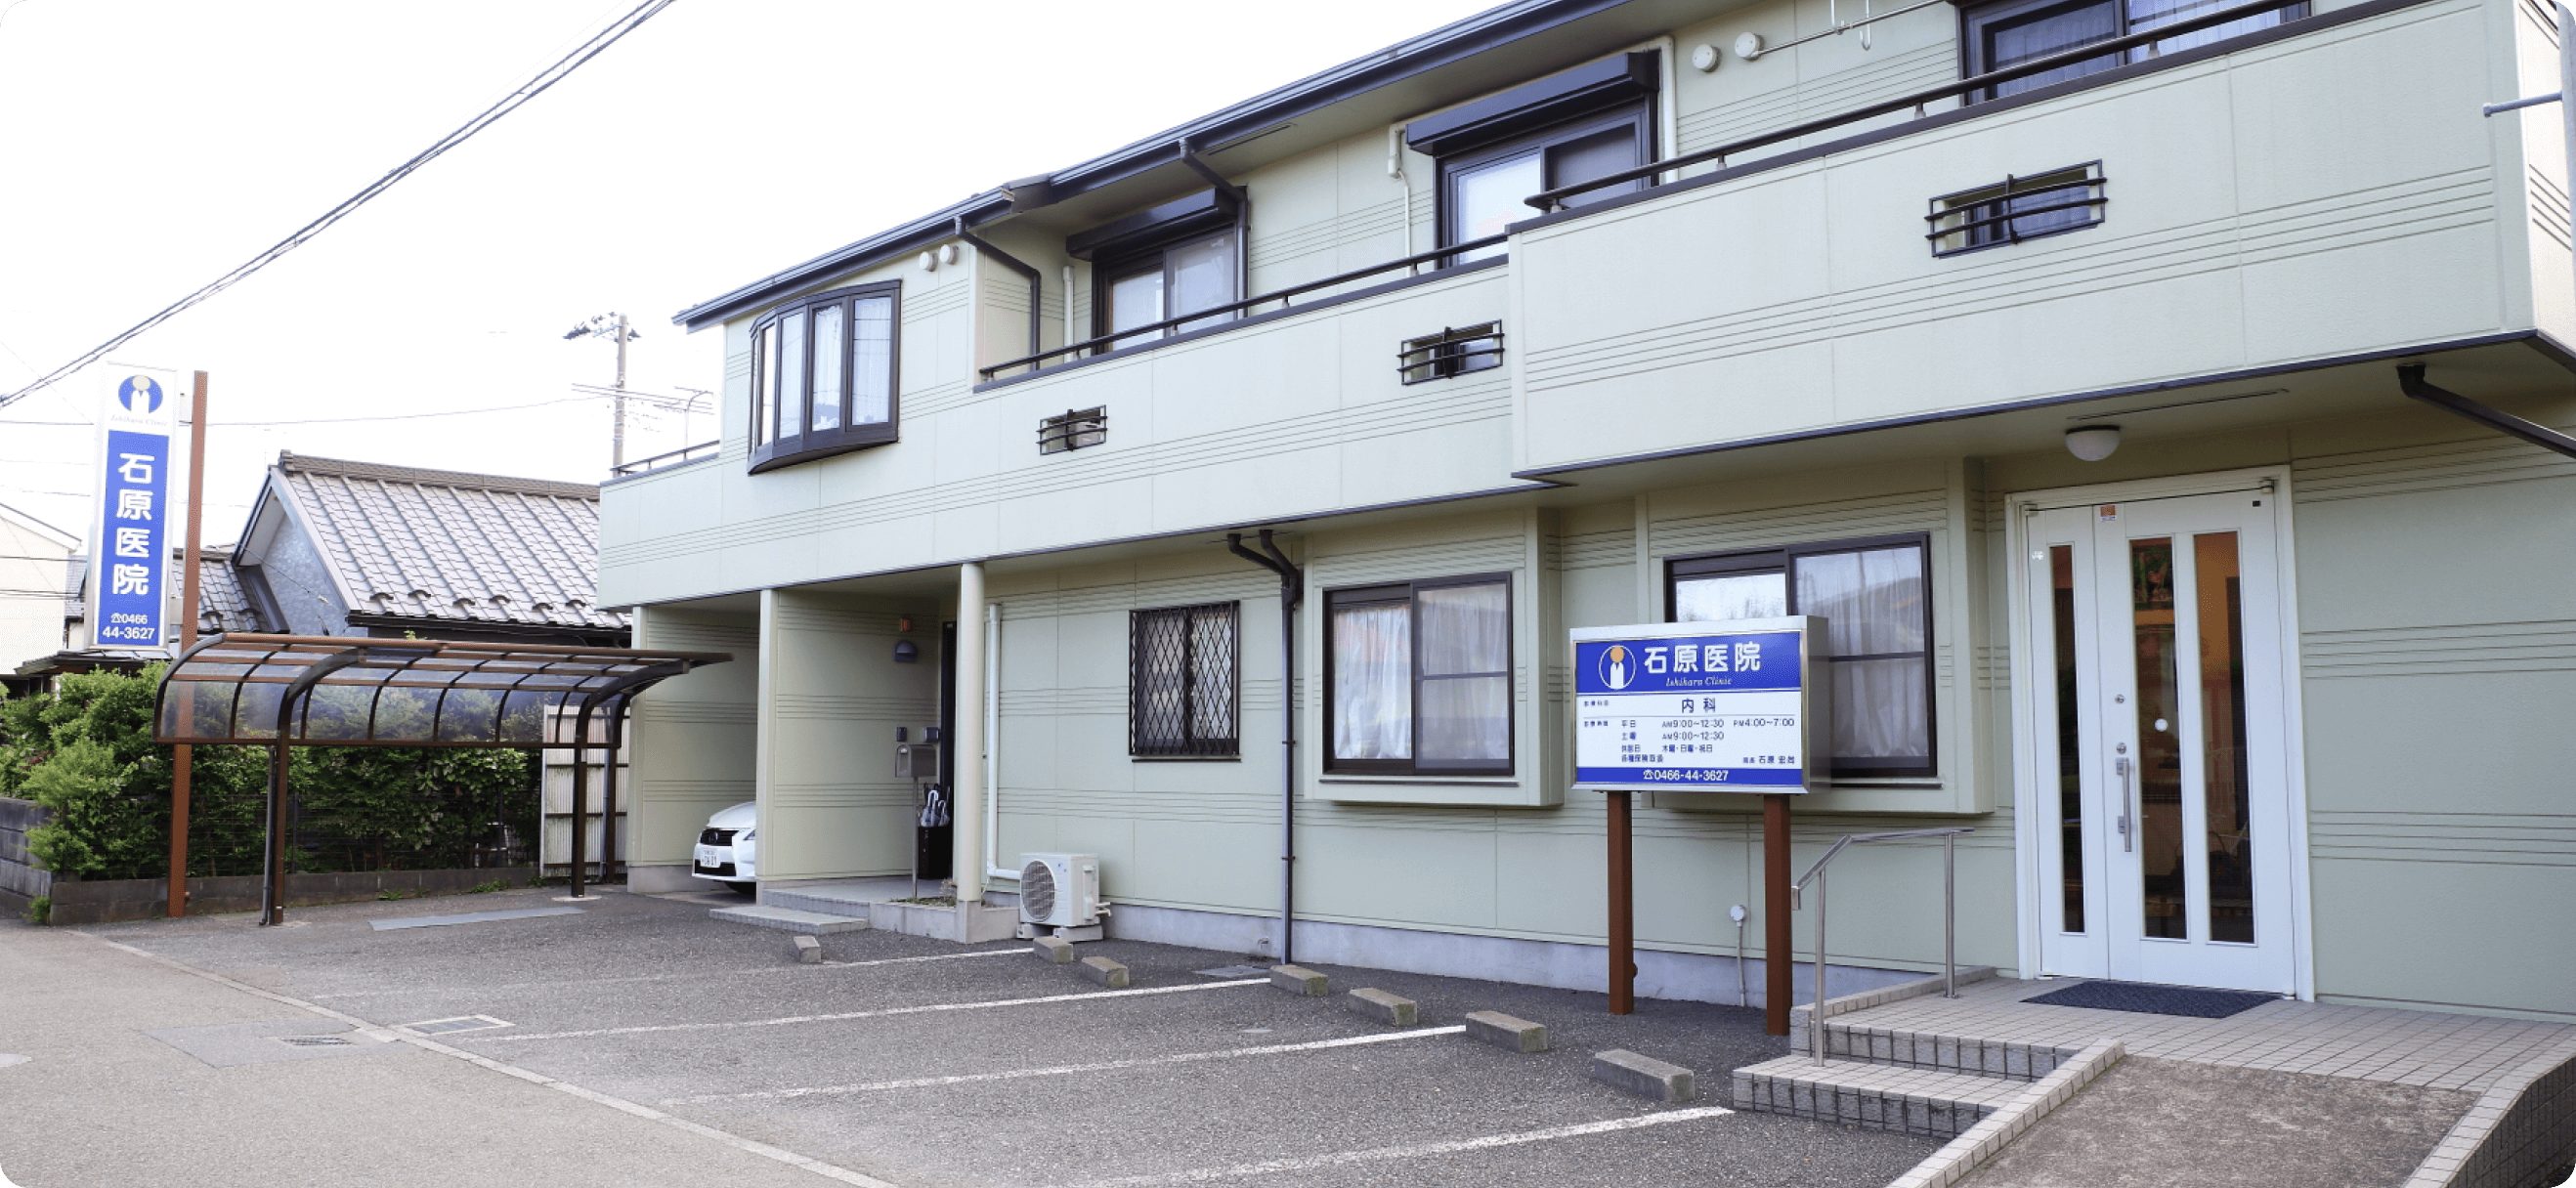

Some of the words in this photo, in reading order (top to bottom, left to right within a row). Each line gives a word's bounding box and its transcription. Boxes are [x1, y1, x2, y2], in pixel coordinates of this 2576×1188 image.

[111, 452, 155, 596] 石原医院
[120, 614, 148, 624] 0466
[103, 625, 155, 640] 44-3627
[1644, 641, 1761, 674] 石原医院
[1666, 677, 1703, 687] Ishihara
[1705, 675, 1732, 686] Clinic
[1681, 698, 1716, 713] 内科
[1654, 770, 1729, 782] 0466-44-3627
